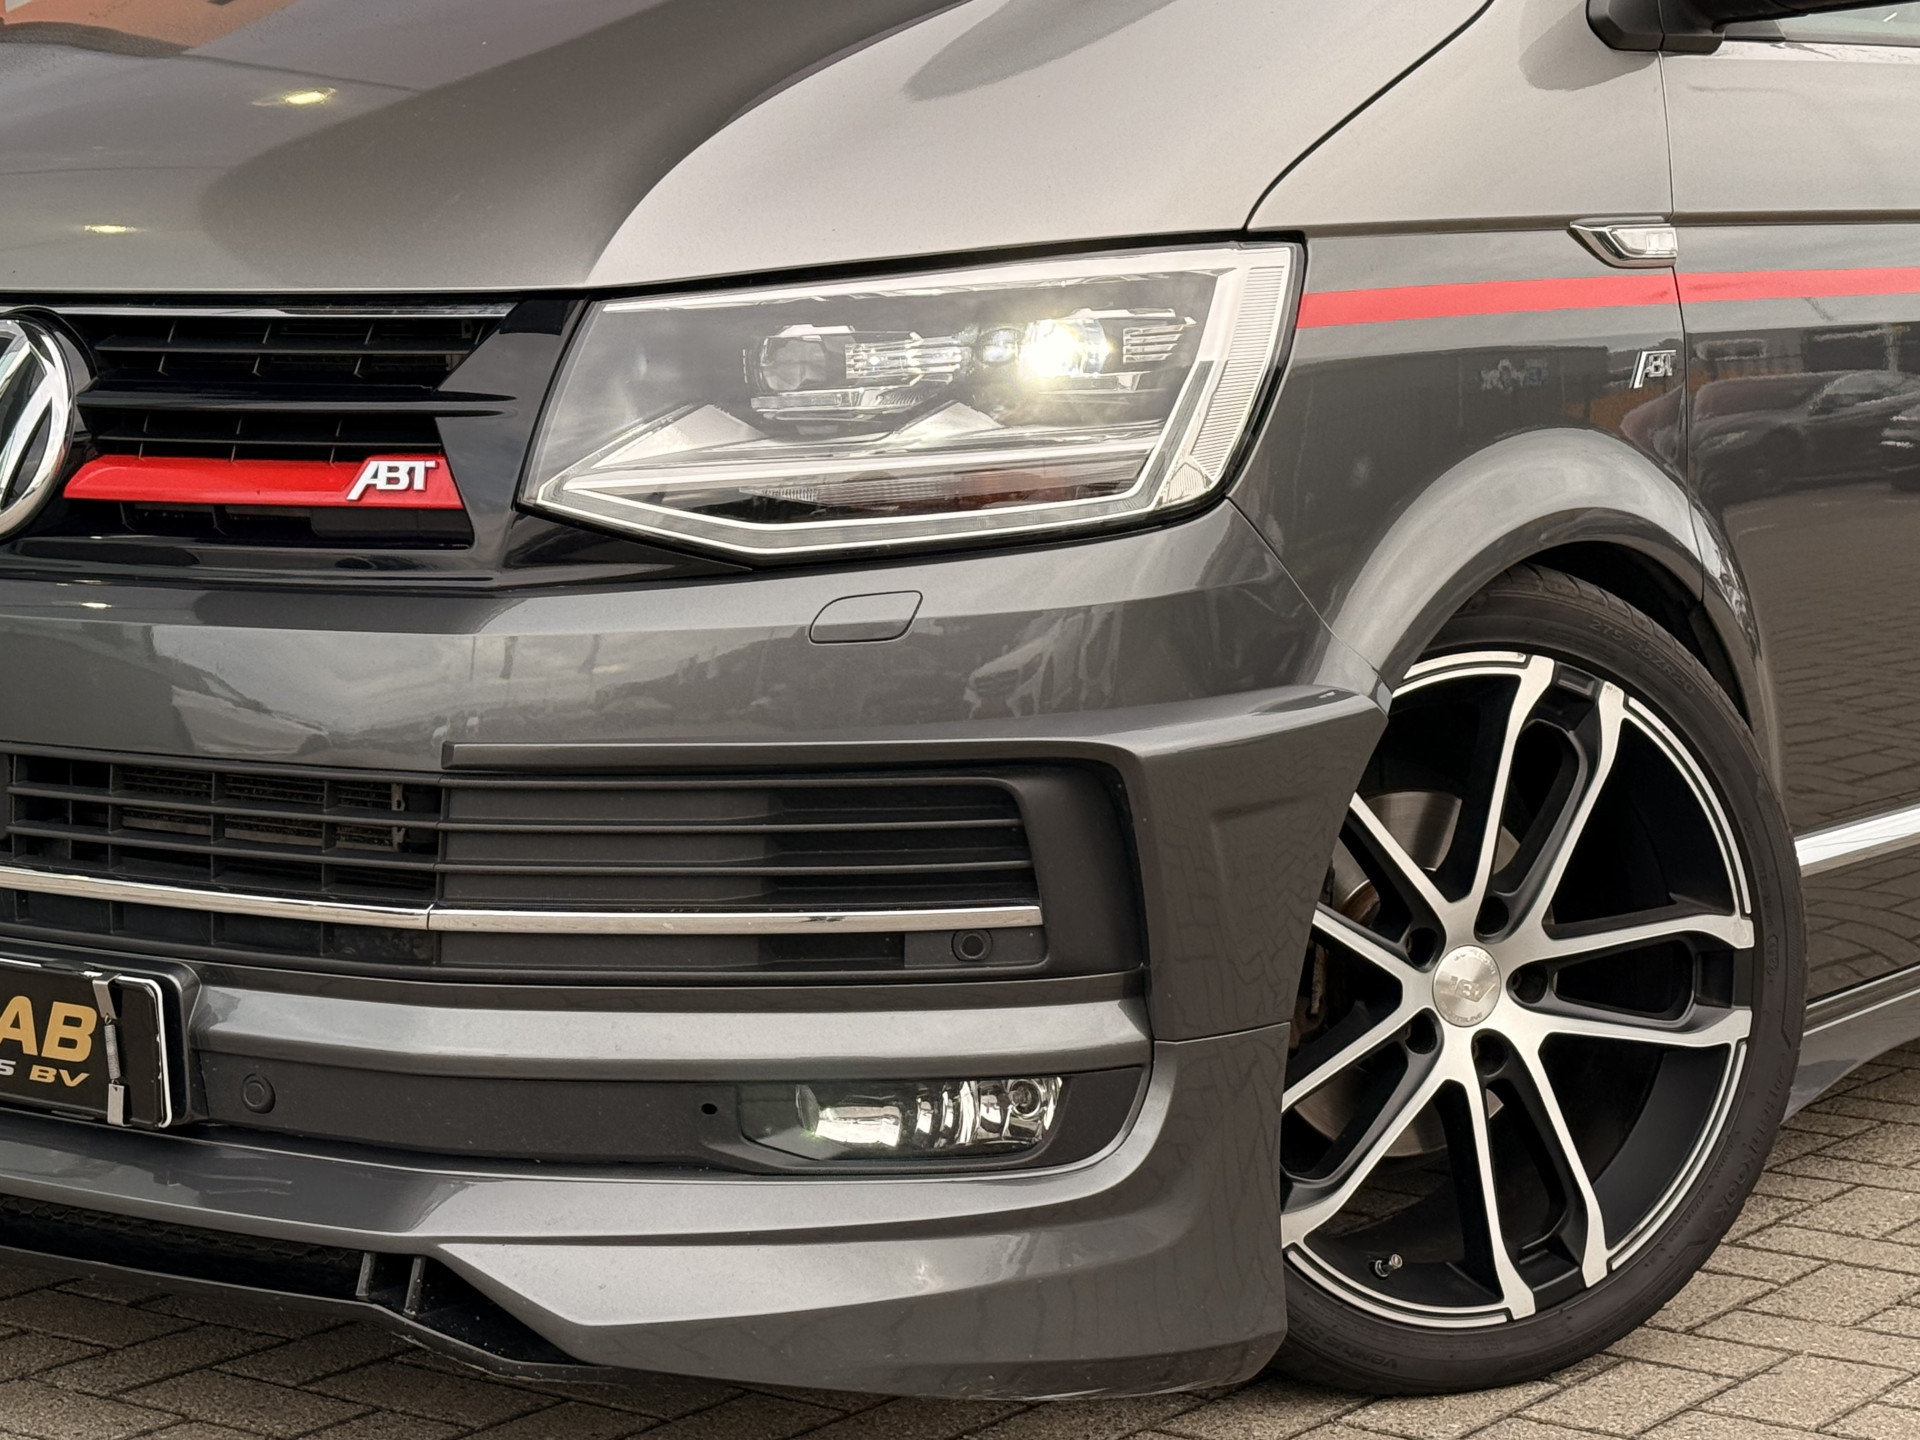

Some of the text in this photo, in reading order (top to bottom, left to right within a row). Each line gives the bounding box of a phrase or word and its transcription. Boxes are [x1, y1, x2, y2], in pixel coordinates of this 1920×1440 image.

[1629, 350, 1677, 389] ABT
[346, 460, 437, 501] ABT
[1588, 618, 1696, 694] 275/35ZR20
[29, 1064, 91, 1088] BV
